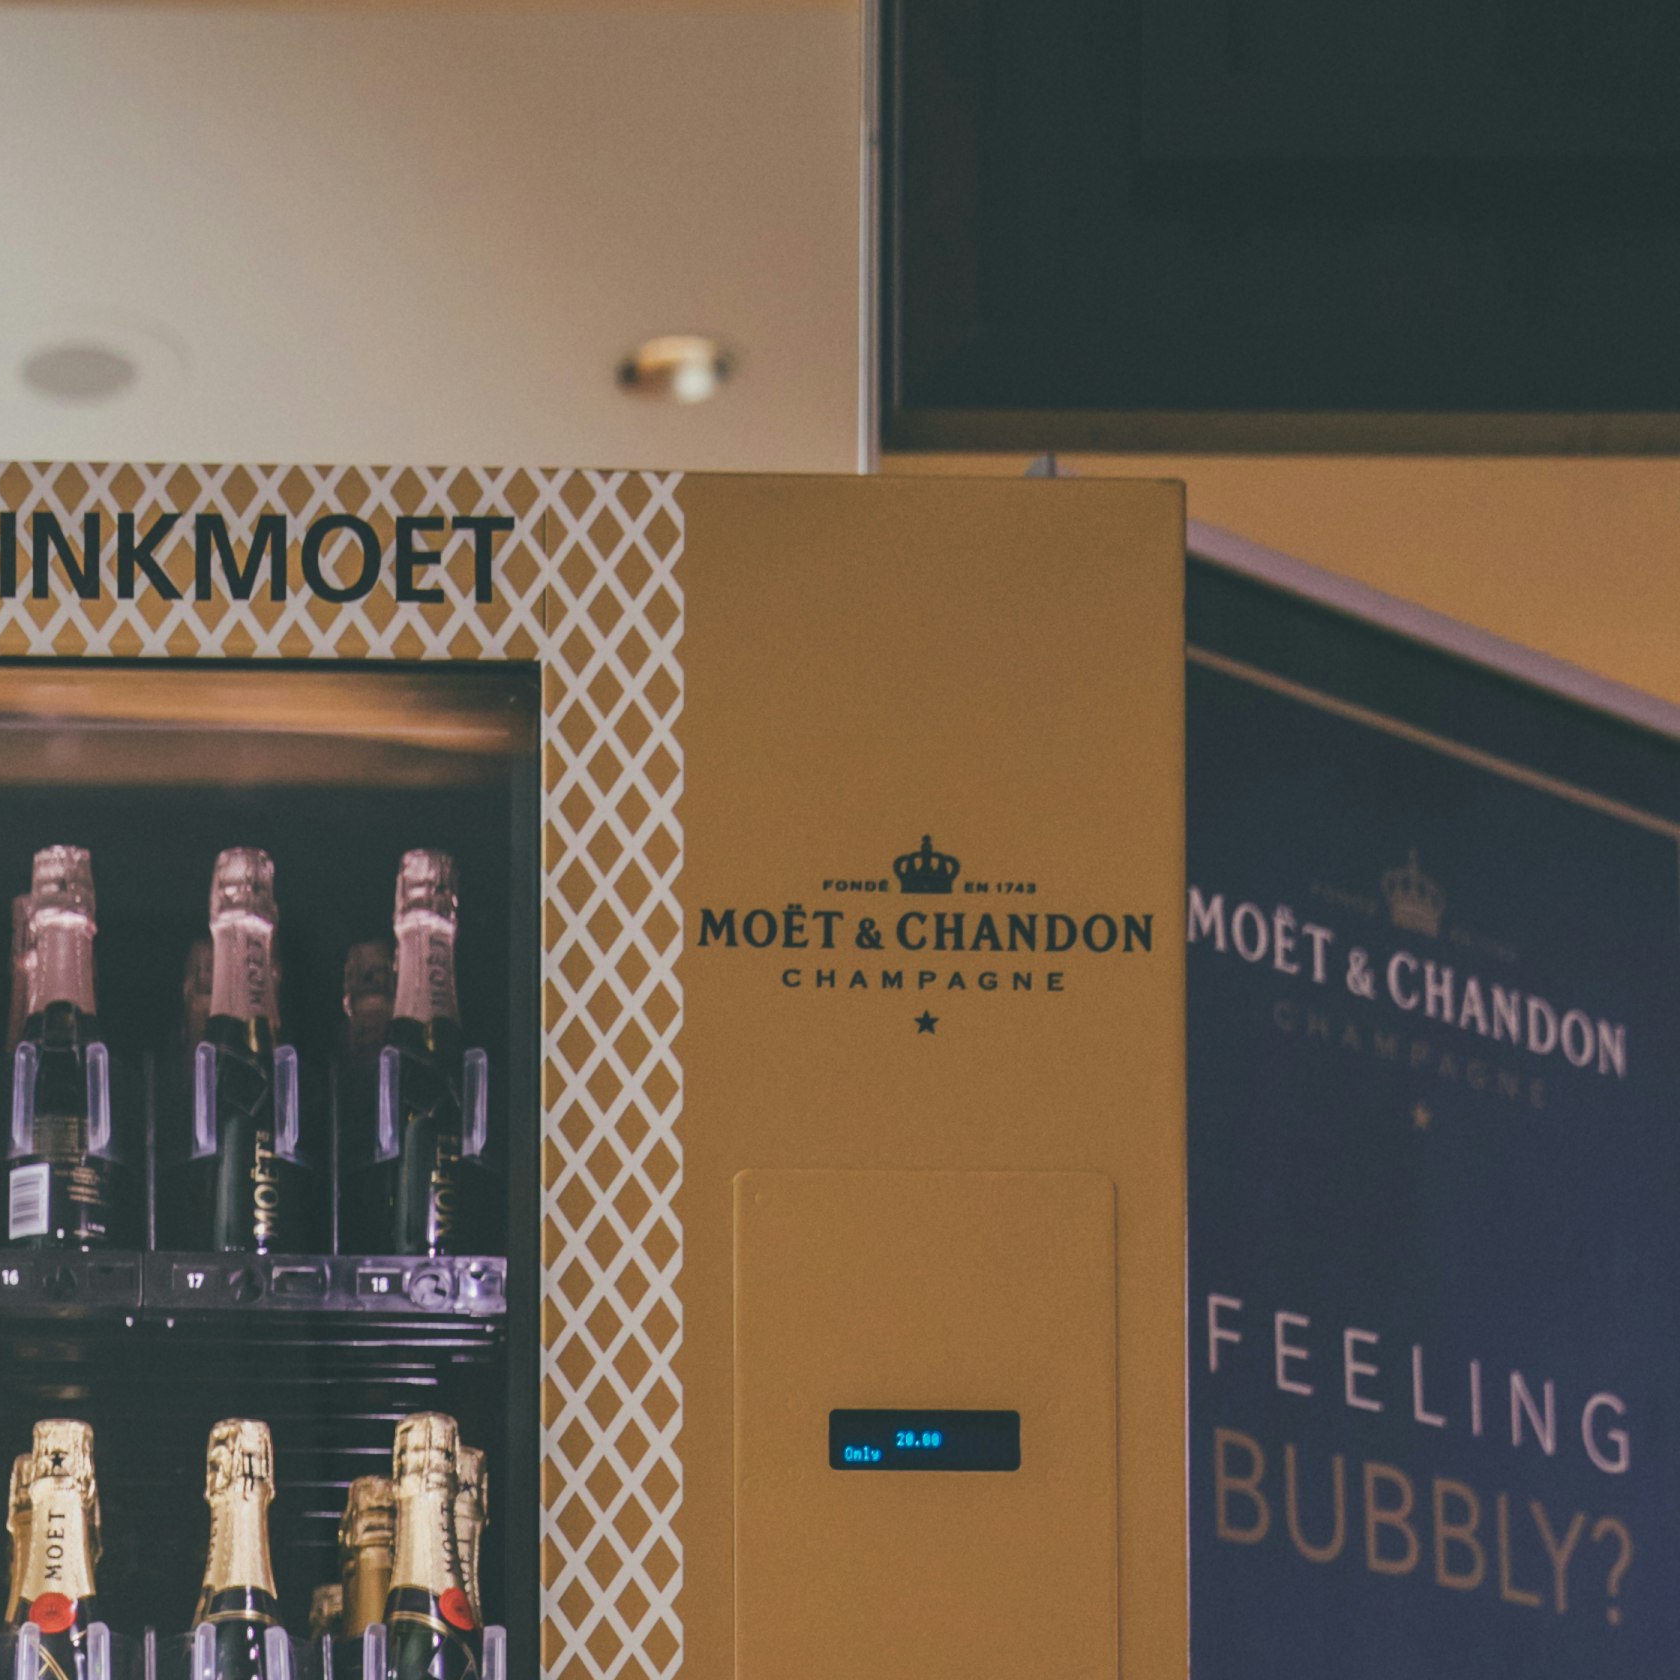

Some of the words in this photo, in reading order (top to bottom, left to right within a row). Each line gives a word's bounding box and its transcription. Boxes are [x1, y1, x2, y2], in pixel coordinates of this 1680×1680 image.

[823, 878, 889, 892] FONDÉ
[964, 882, 989, 894] EN
[996, 882, 1036, 894] 1743
[697, 904, 843, 949] MOËT
[855, 917, 885, 950] &
[896, 911, 1154, 953] CHANDON
[782, 968, 1065, 992] CHAMPAGNE
[1188, 885, 1335, 985] MOËT
[1345, 946, 1376, 1000] &
[1387, 950, 1627, 1079] CHANDON
[2, 1270, 19, 1286] 16
[187, 1273, 204, 1289] 17
[371, 1278, 389, 1293] 18
[1207, 1293, 1630, 1475] FEELING
[896, 1432, 941, 1447] 20.00
[844, 1446, 881, 1462] Only
[1214, 1426, 1634, 1626] BUBBLY?
